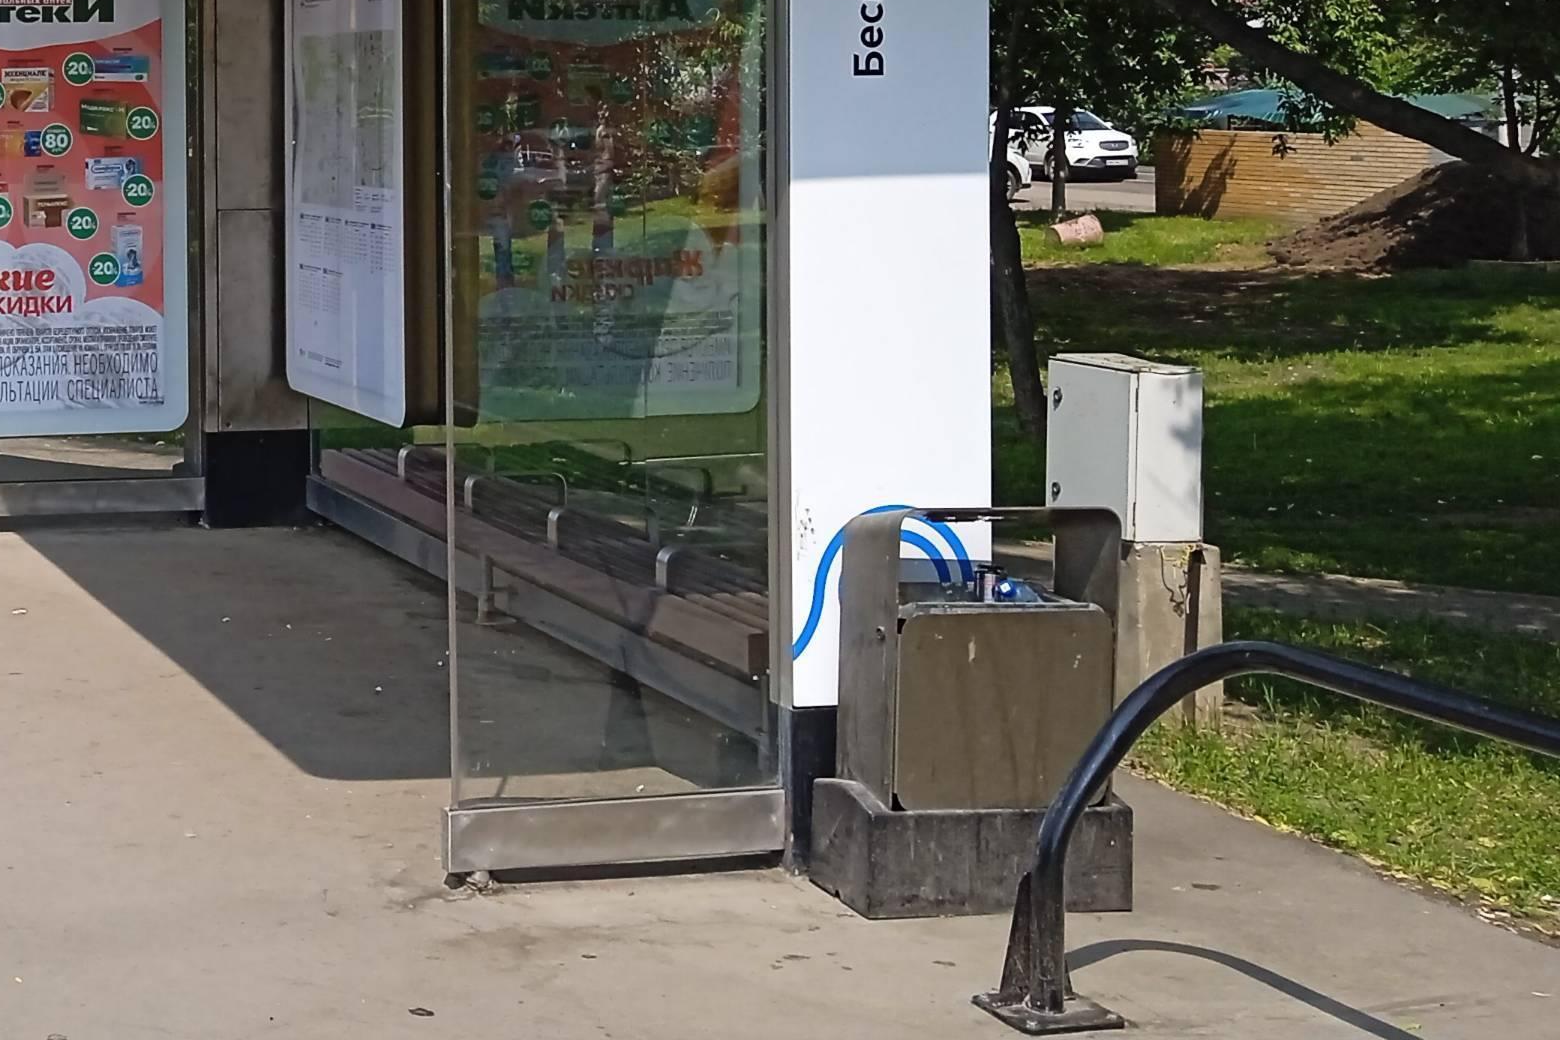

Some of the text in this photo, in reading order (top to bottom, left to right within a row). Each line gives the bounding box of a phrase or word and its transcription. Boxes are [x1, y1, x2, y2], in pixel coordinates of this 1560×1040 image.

[45, 134, 68, 148] 80
[73, 351, 158, 377] НЕОБХОДИМО
[67, 377, 159, 401] СПЕЦИАЛИСТА
